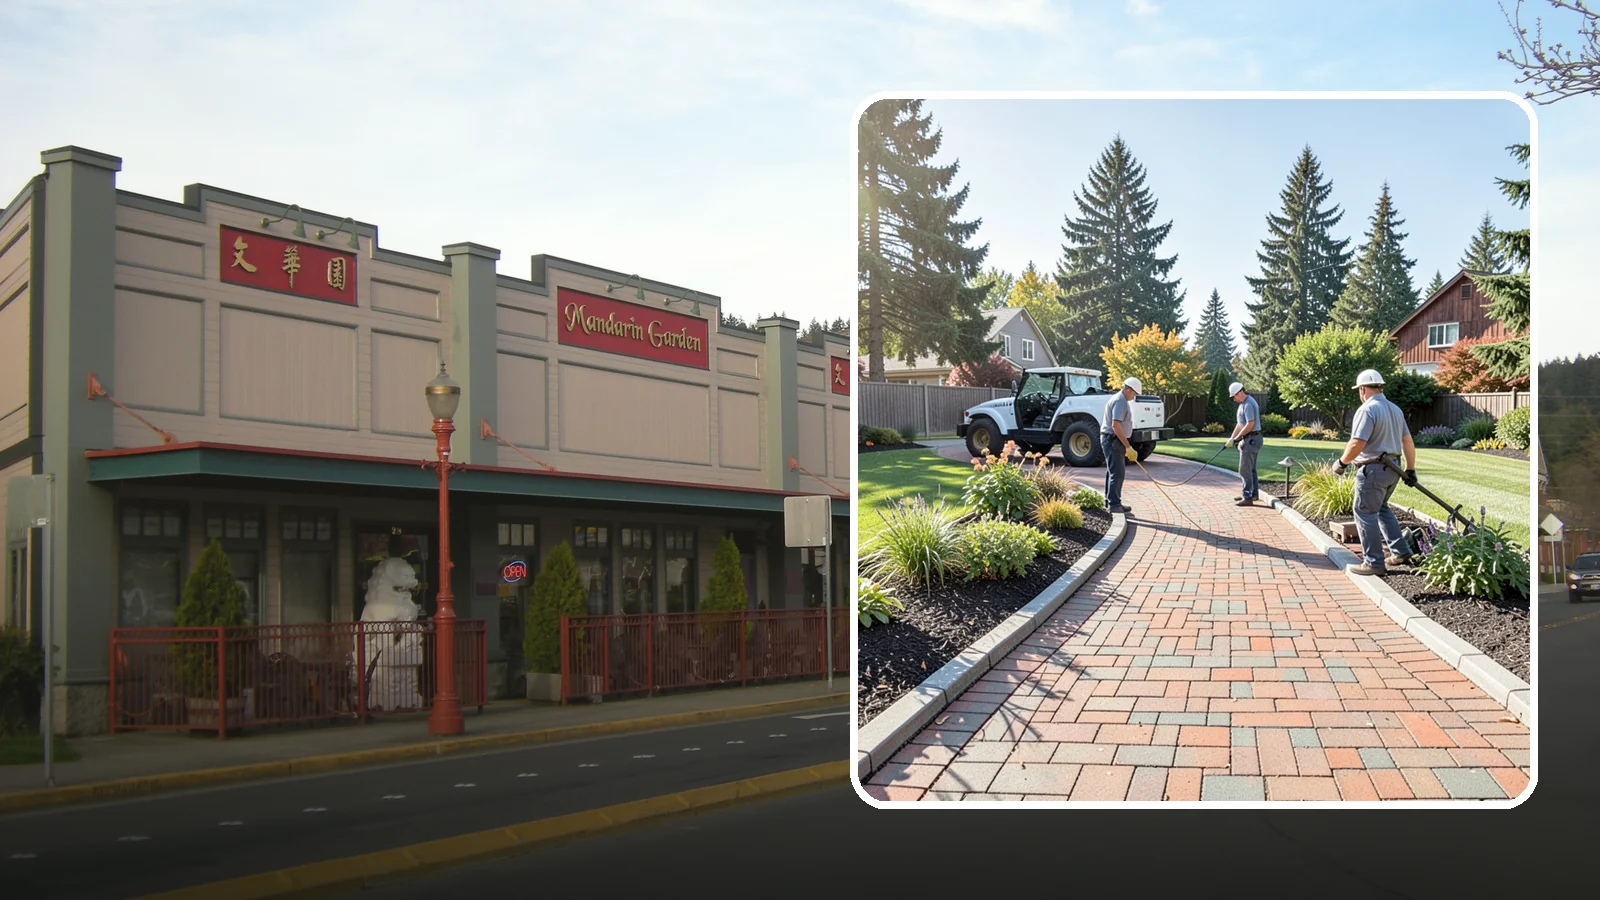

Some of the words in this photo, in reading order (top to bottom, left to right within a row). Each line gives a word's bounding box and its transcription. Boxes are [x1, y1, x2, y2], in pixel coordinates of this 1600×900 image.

[231, 236, 346, 290] 文華園
[565, 302, 643, 340] Mandarin
[648, 320, 701, 352] Garden
[503, 565, 526, 578] OPEN
